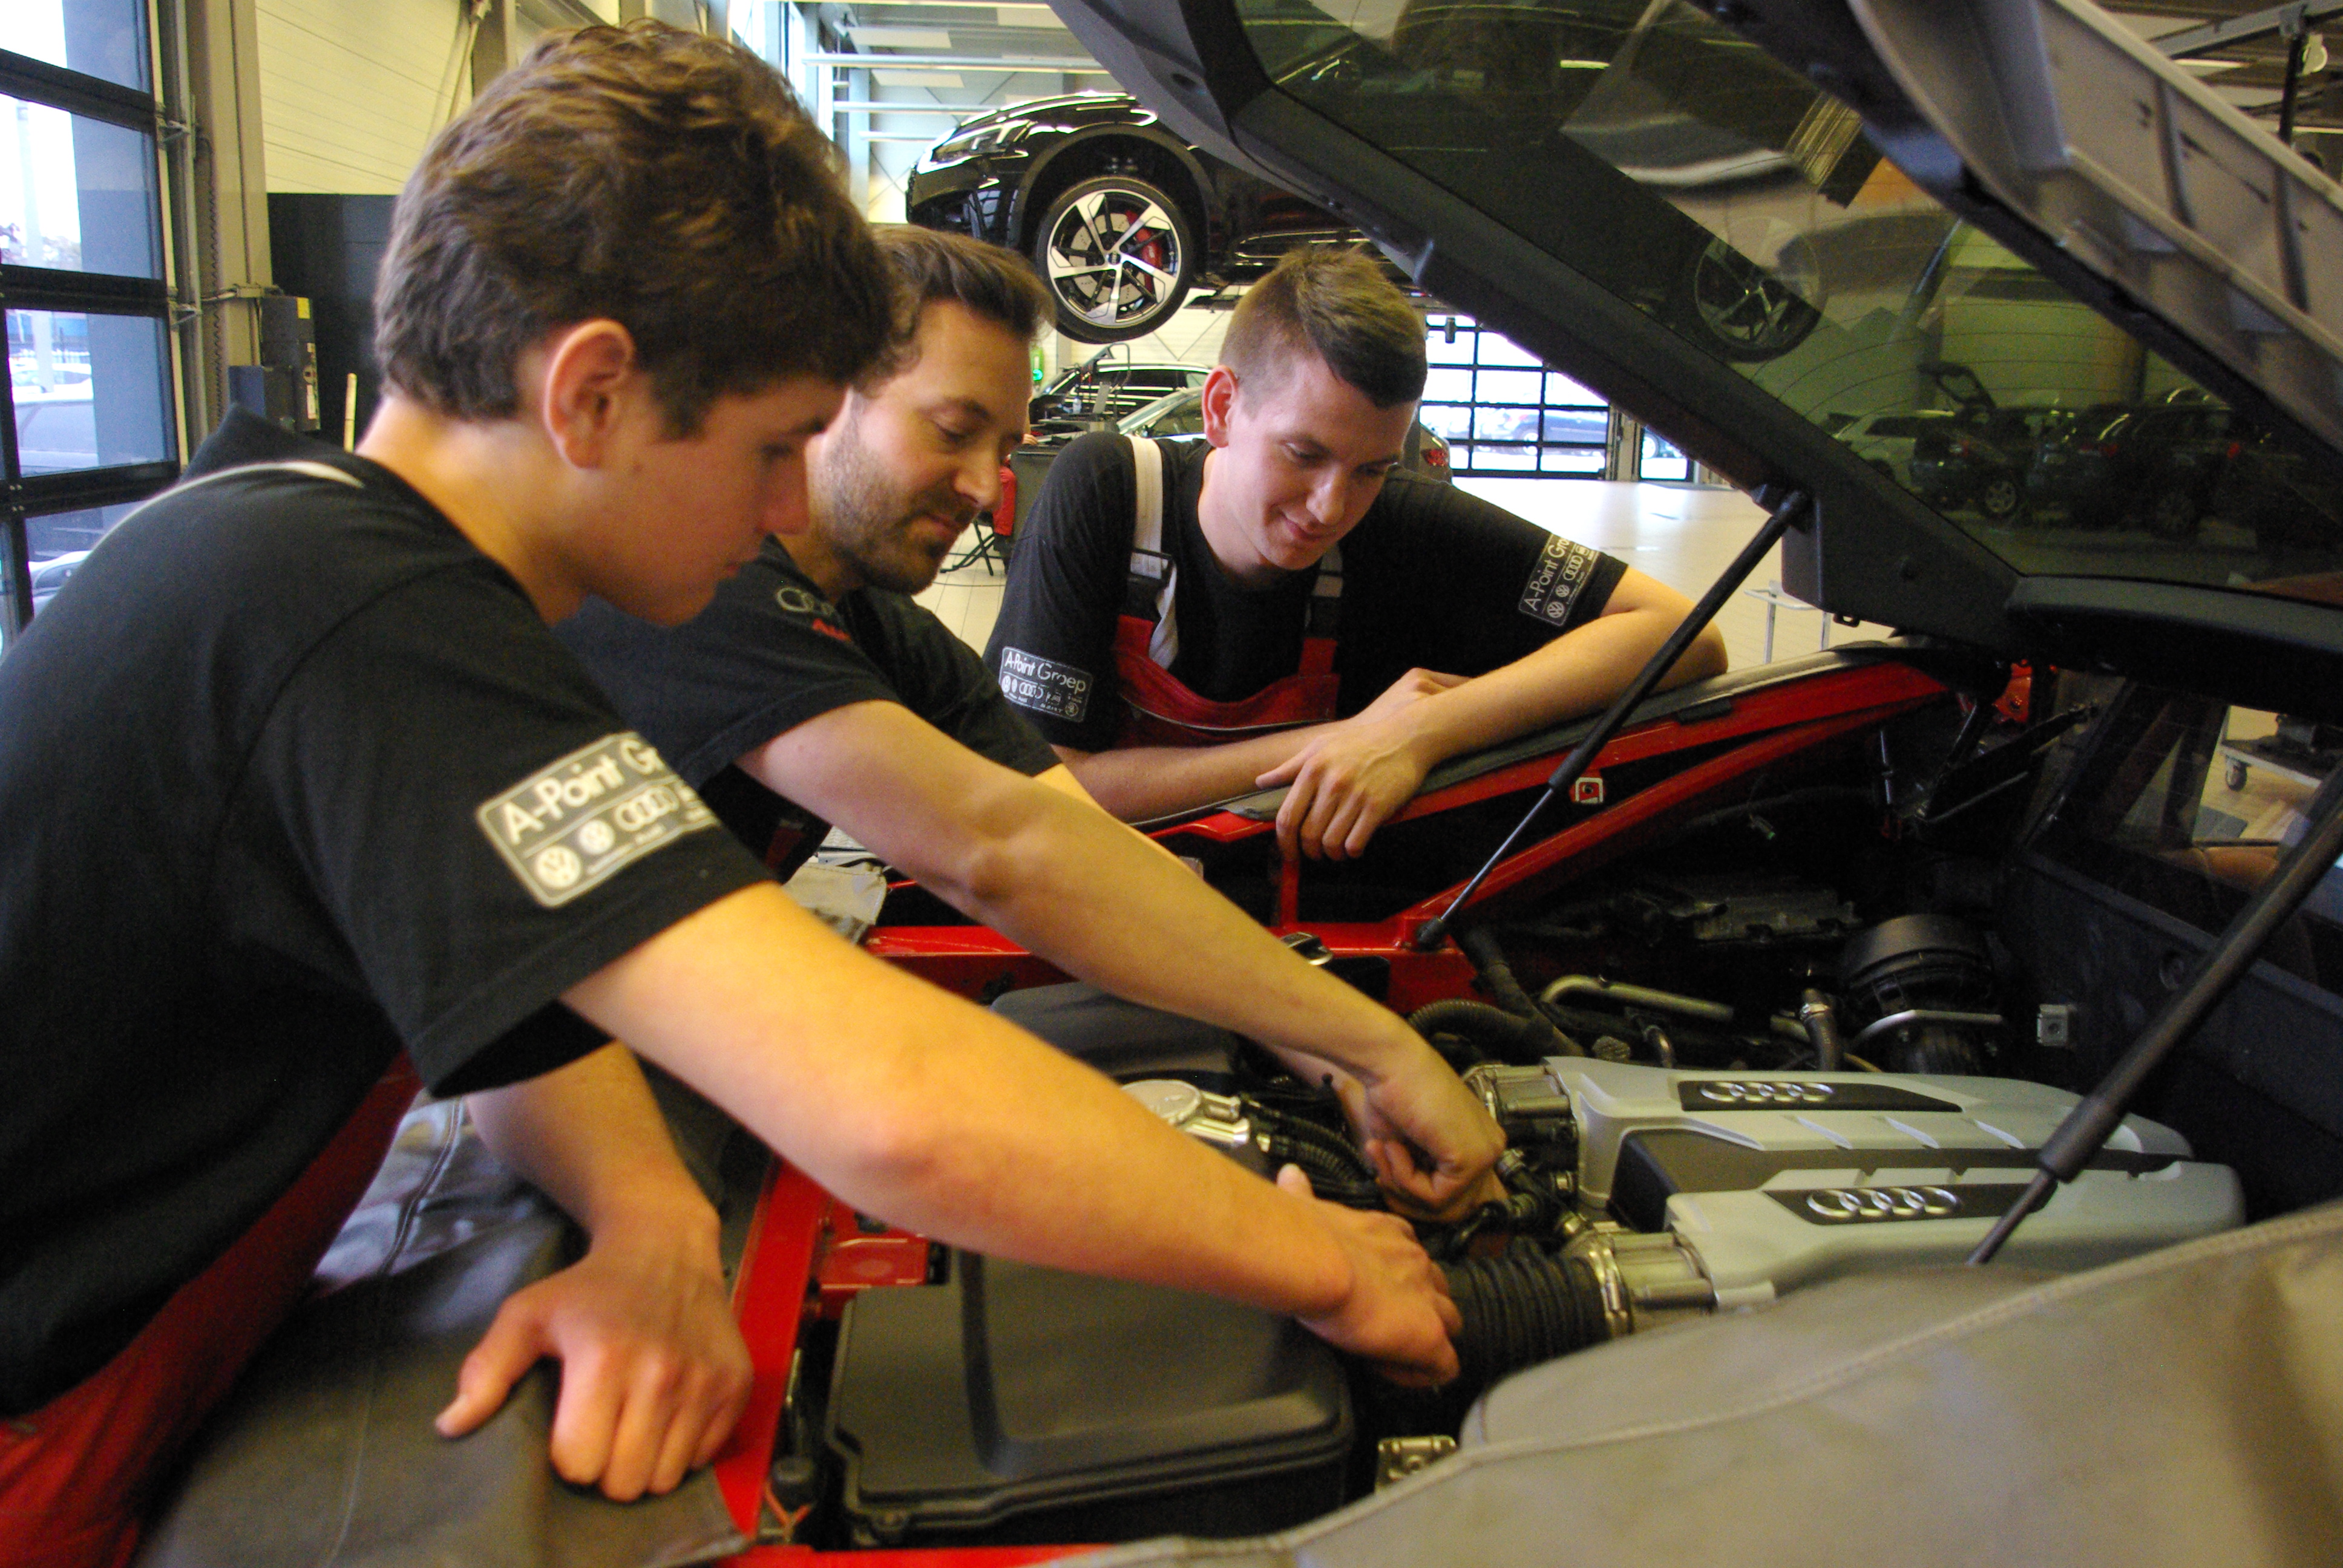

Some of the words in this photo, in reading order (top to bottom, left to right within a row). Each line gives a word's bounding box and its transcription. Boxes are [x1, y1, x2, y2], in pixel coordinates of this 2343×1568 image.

[1523, 558, 1558, 612] A-Point
[1004, 651, 1036, 676] A-Point
[502, 755, 625, 845] A-Point
